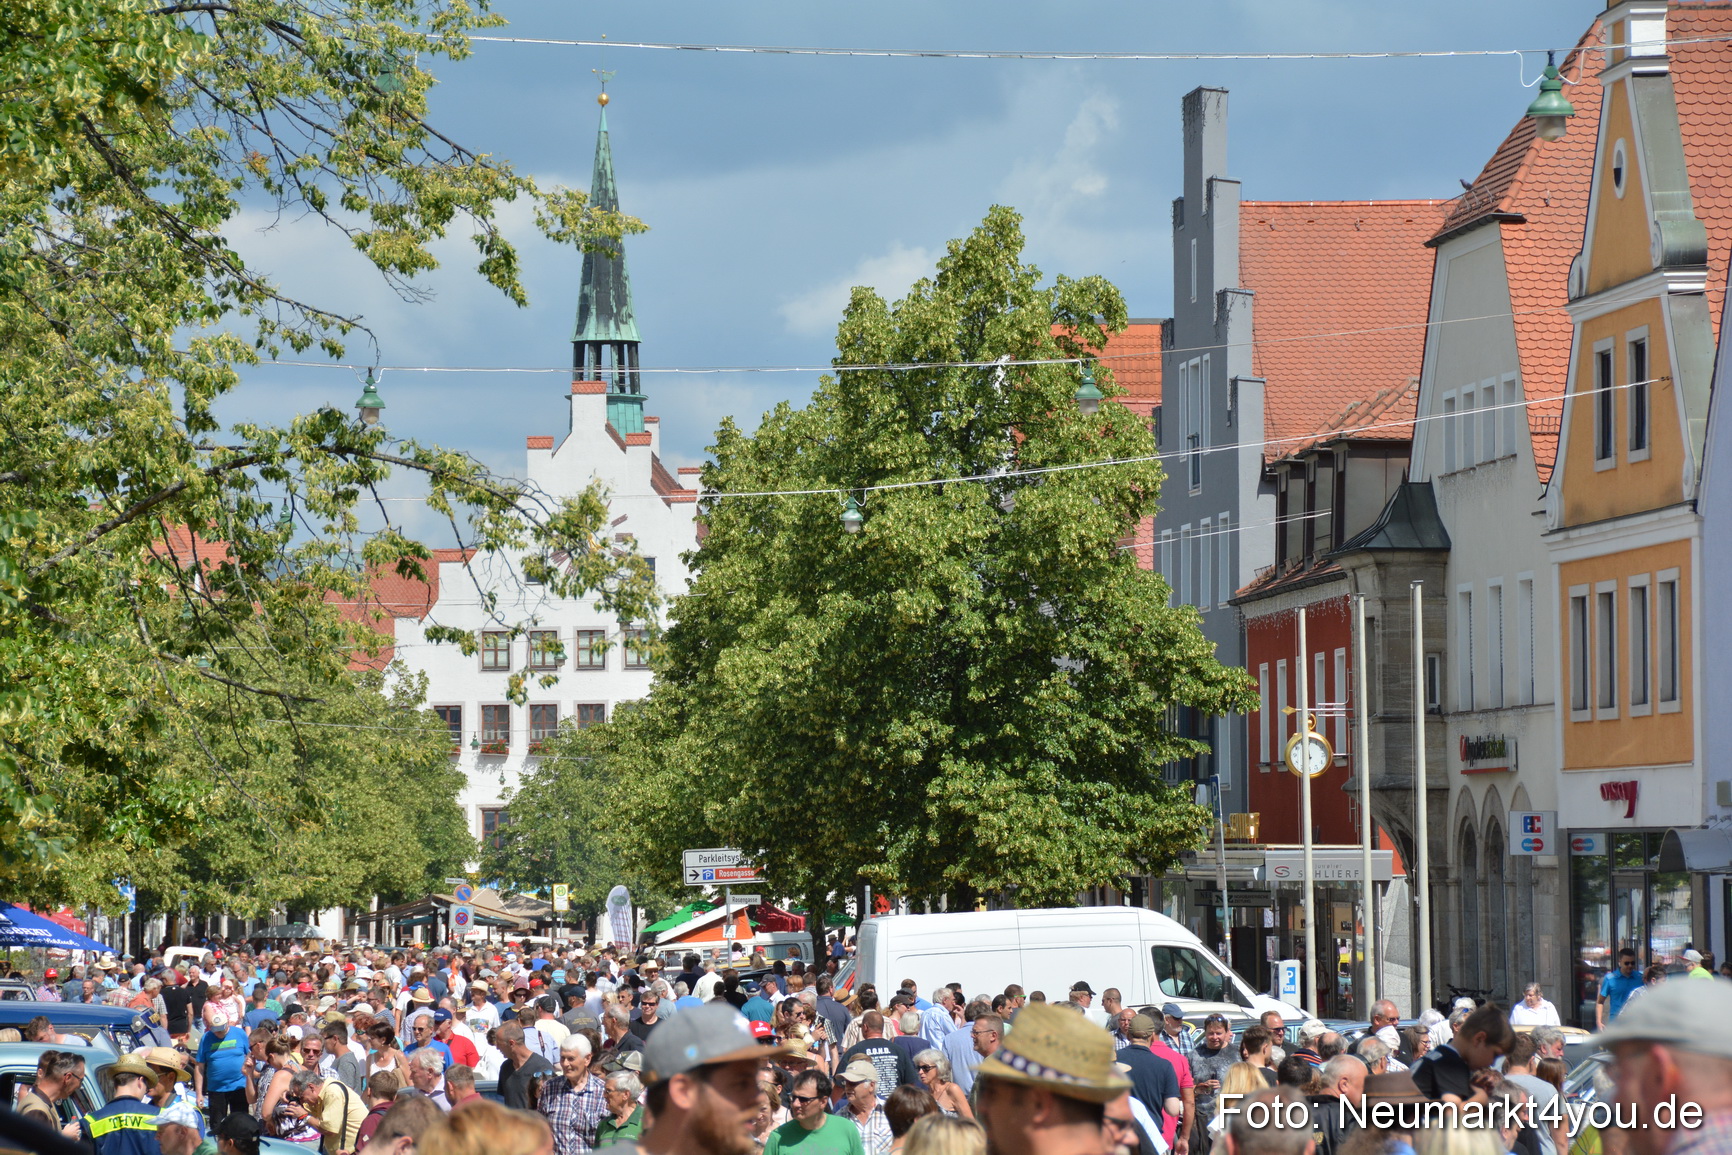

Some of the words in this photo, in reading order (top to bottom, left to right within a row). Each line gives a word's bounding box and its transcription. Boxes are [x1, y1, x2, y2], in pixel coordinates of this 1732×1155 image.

[699, 853, 752, 864] Parkleitsys
[718, 869, 755, 879] Rosengasse
[1298, 869, 1360, 878] SHLIERF
[732, 896, 758, 904] Rosengasse
[109, 1115, 143, 1129] THW
